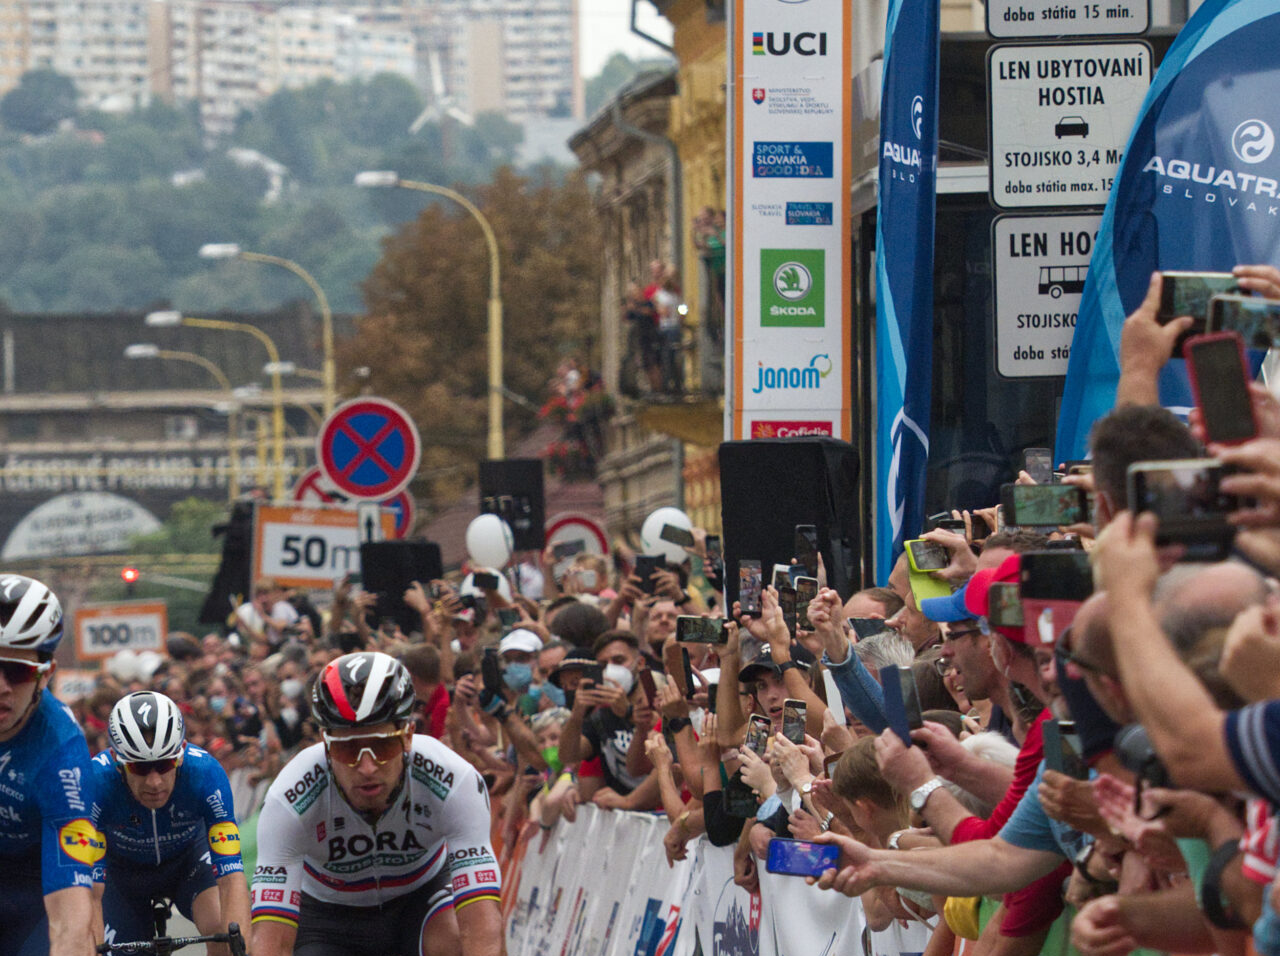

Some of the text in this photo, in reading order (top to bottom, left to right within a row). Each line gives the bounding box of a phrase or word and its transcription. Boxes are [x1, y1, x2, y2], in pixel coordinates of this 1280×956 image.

[1003, 4, 1134, 22] doba státia 15 min.
[766, 32, 828, 56] UCI
[999, 52, 1144, 80] LEN UBYTOVANÍ
[1038, 85, 1105, 106] HOSTIA
[756, 144, 803, 154] SPORT &
[756, 155, 808, 165] SLOVAKIA
[1005, 150, 1072, 168] STOJISKO
[1077, 150, 1100, 168] 3,4
[1005, 180, 1033, 194] doba
[1036, 179, 1067, 194] státia
[1070, 180, 1099, 193] max.
[1142, 156, 1280, 200] AQUATR
[1009, 232, 1048, 258] LEN
[769, 305, 816, 316] ŠKODA
[1016, 313, 1078, 329] STOJISKO
[1013, 345, 1045, 361] doba
[752, 361, 821, 394] janom
[87, 624, 157, 647] 100m
[413, 751, 455, 789] BORA
[284, 763, 325, 804] BORA
[328, 830, 426, 863] BORA
